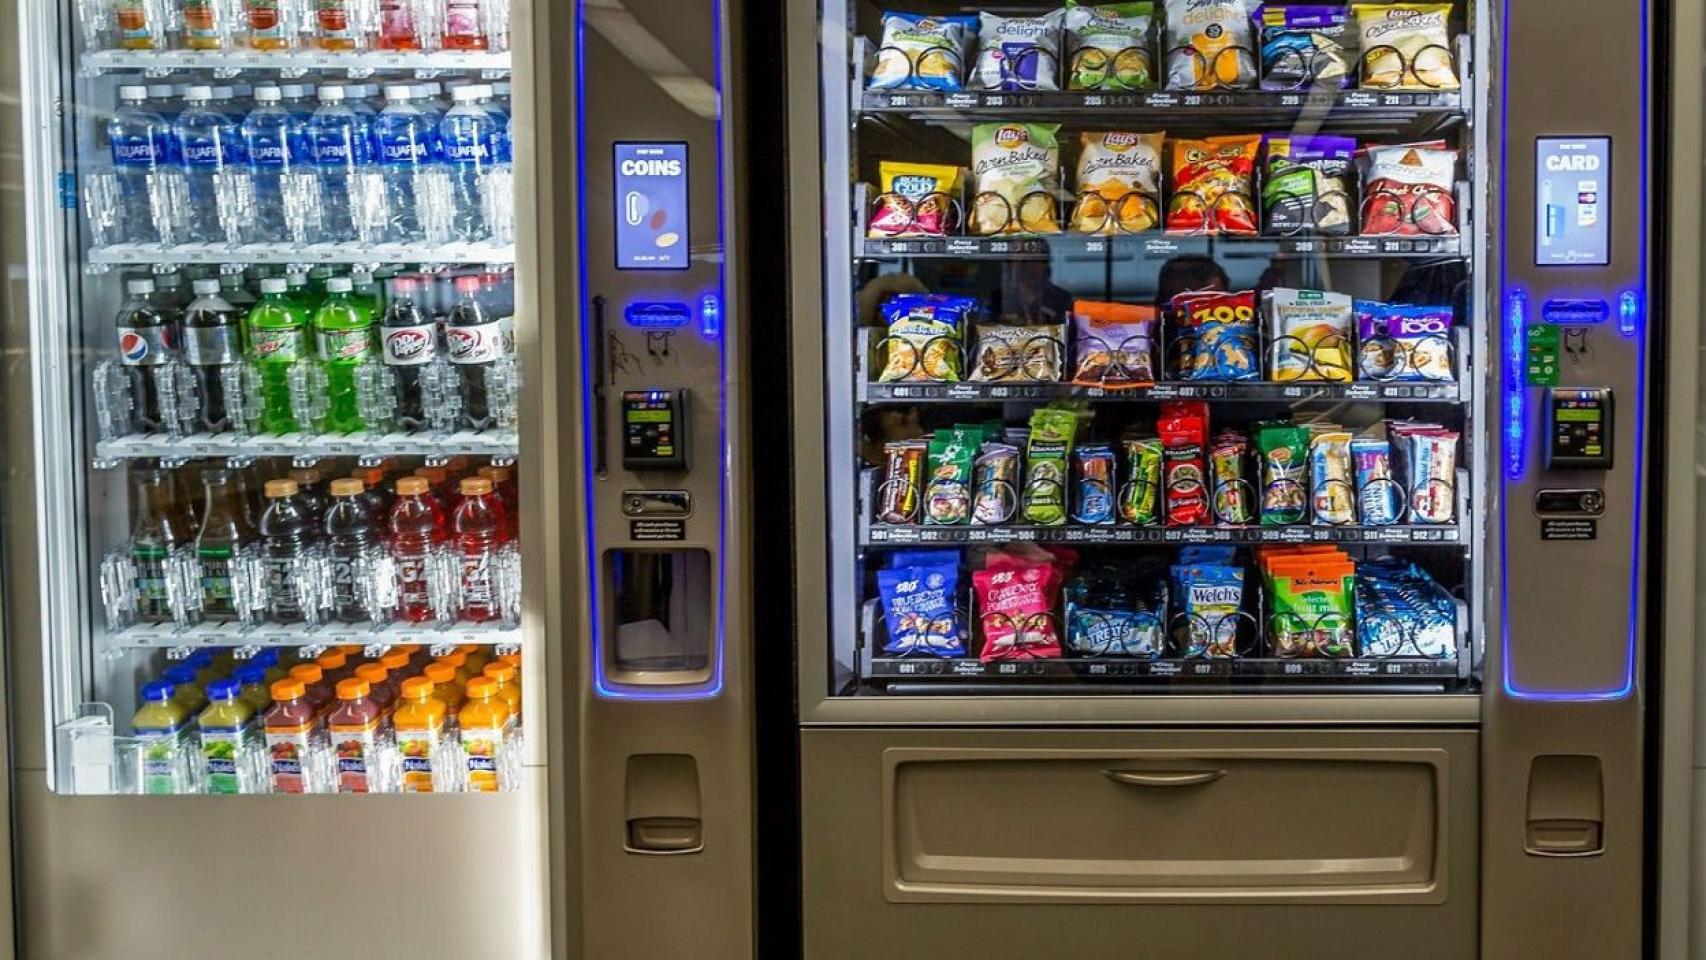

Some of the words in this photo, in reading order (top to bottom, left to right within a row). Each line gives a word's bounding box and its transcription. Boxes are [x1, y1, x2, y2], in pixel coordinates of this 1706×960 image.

[890, 96, 906, 105] 201
[1385, 95, 1399, 104] 211
[1009, 146, 1049, 163] Baked
[1115, 153, 1153, 166] Baked
[1546, 155, 1600, 171] CARD
[621, 160, 681, 176] COINS
[892, 242, 907, 252] 301
[1401, 320, 1443, 333] 100
[871, 531, 887, 540] 501
[921, 531, 938, 540] 502
[969, 531, 986, 540] 503
[1363, 531, 1378, 540] 511
[1412, 531, 1428, 540] 512
[1193, 587, 1240, 602] Welch's
